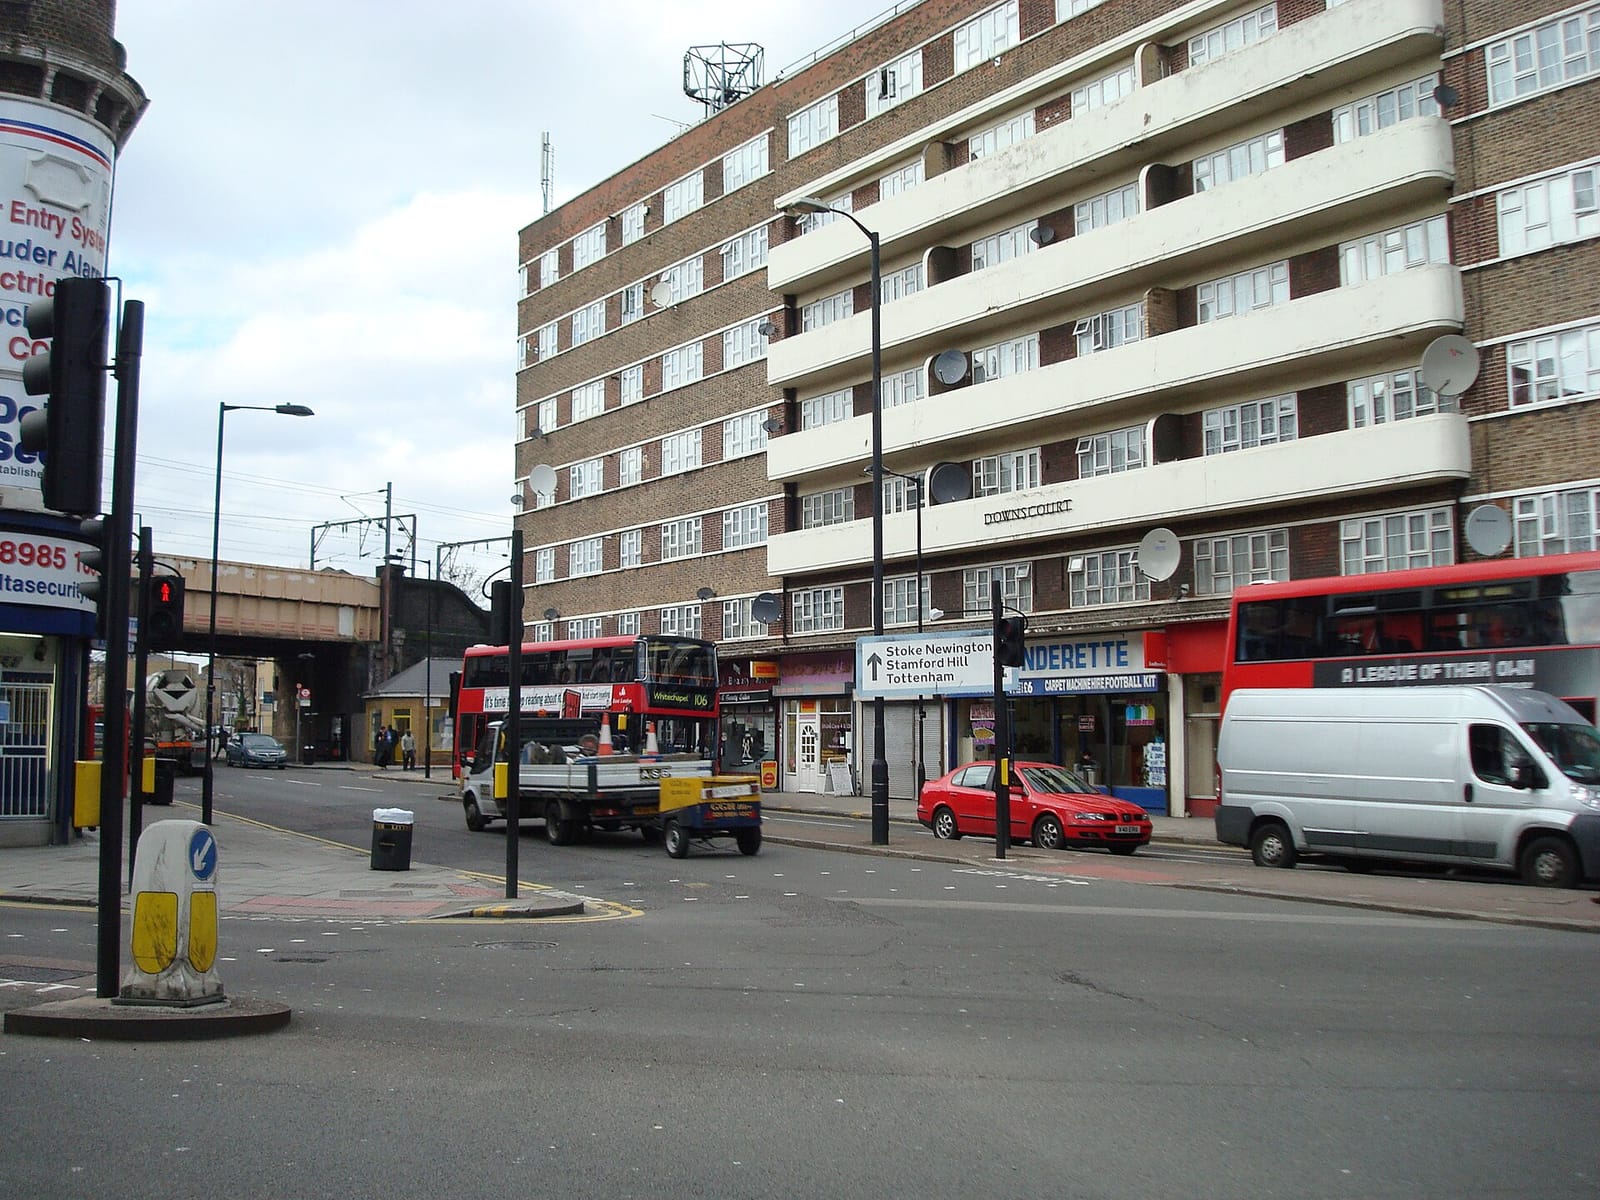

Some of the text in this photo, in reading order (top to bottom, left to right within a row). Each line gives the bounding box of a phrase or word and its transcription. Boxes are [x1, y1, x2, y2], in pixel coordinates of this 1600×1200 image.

[10, 200, 66, 239] Entry
[0, 540, 66, 570] 8985
[886, 642, 993, 657] Stoke Newington
[886, 656, 969, 671] Stamford Hill
[1341, 667, 1353, 682] A
[1356, 664, 1418, 682] LEAGUE
[1419, 663, 1442, 679] OF
[1442, 661, 1491, 678] THEIR
[886, 671, 954, 684] Tottenham
[1105, 676, 1142, 690] FOOTBALL
[1143, 675, 1156, 688] KIT
[653, 690, 689, 703] Whitechapel
[694, 694, 708, 707] 106
